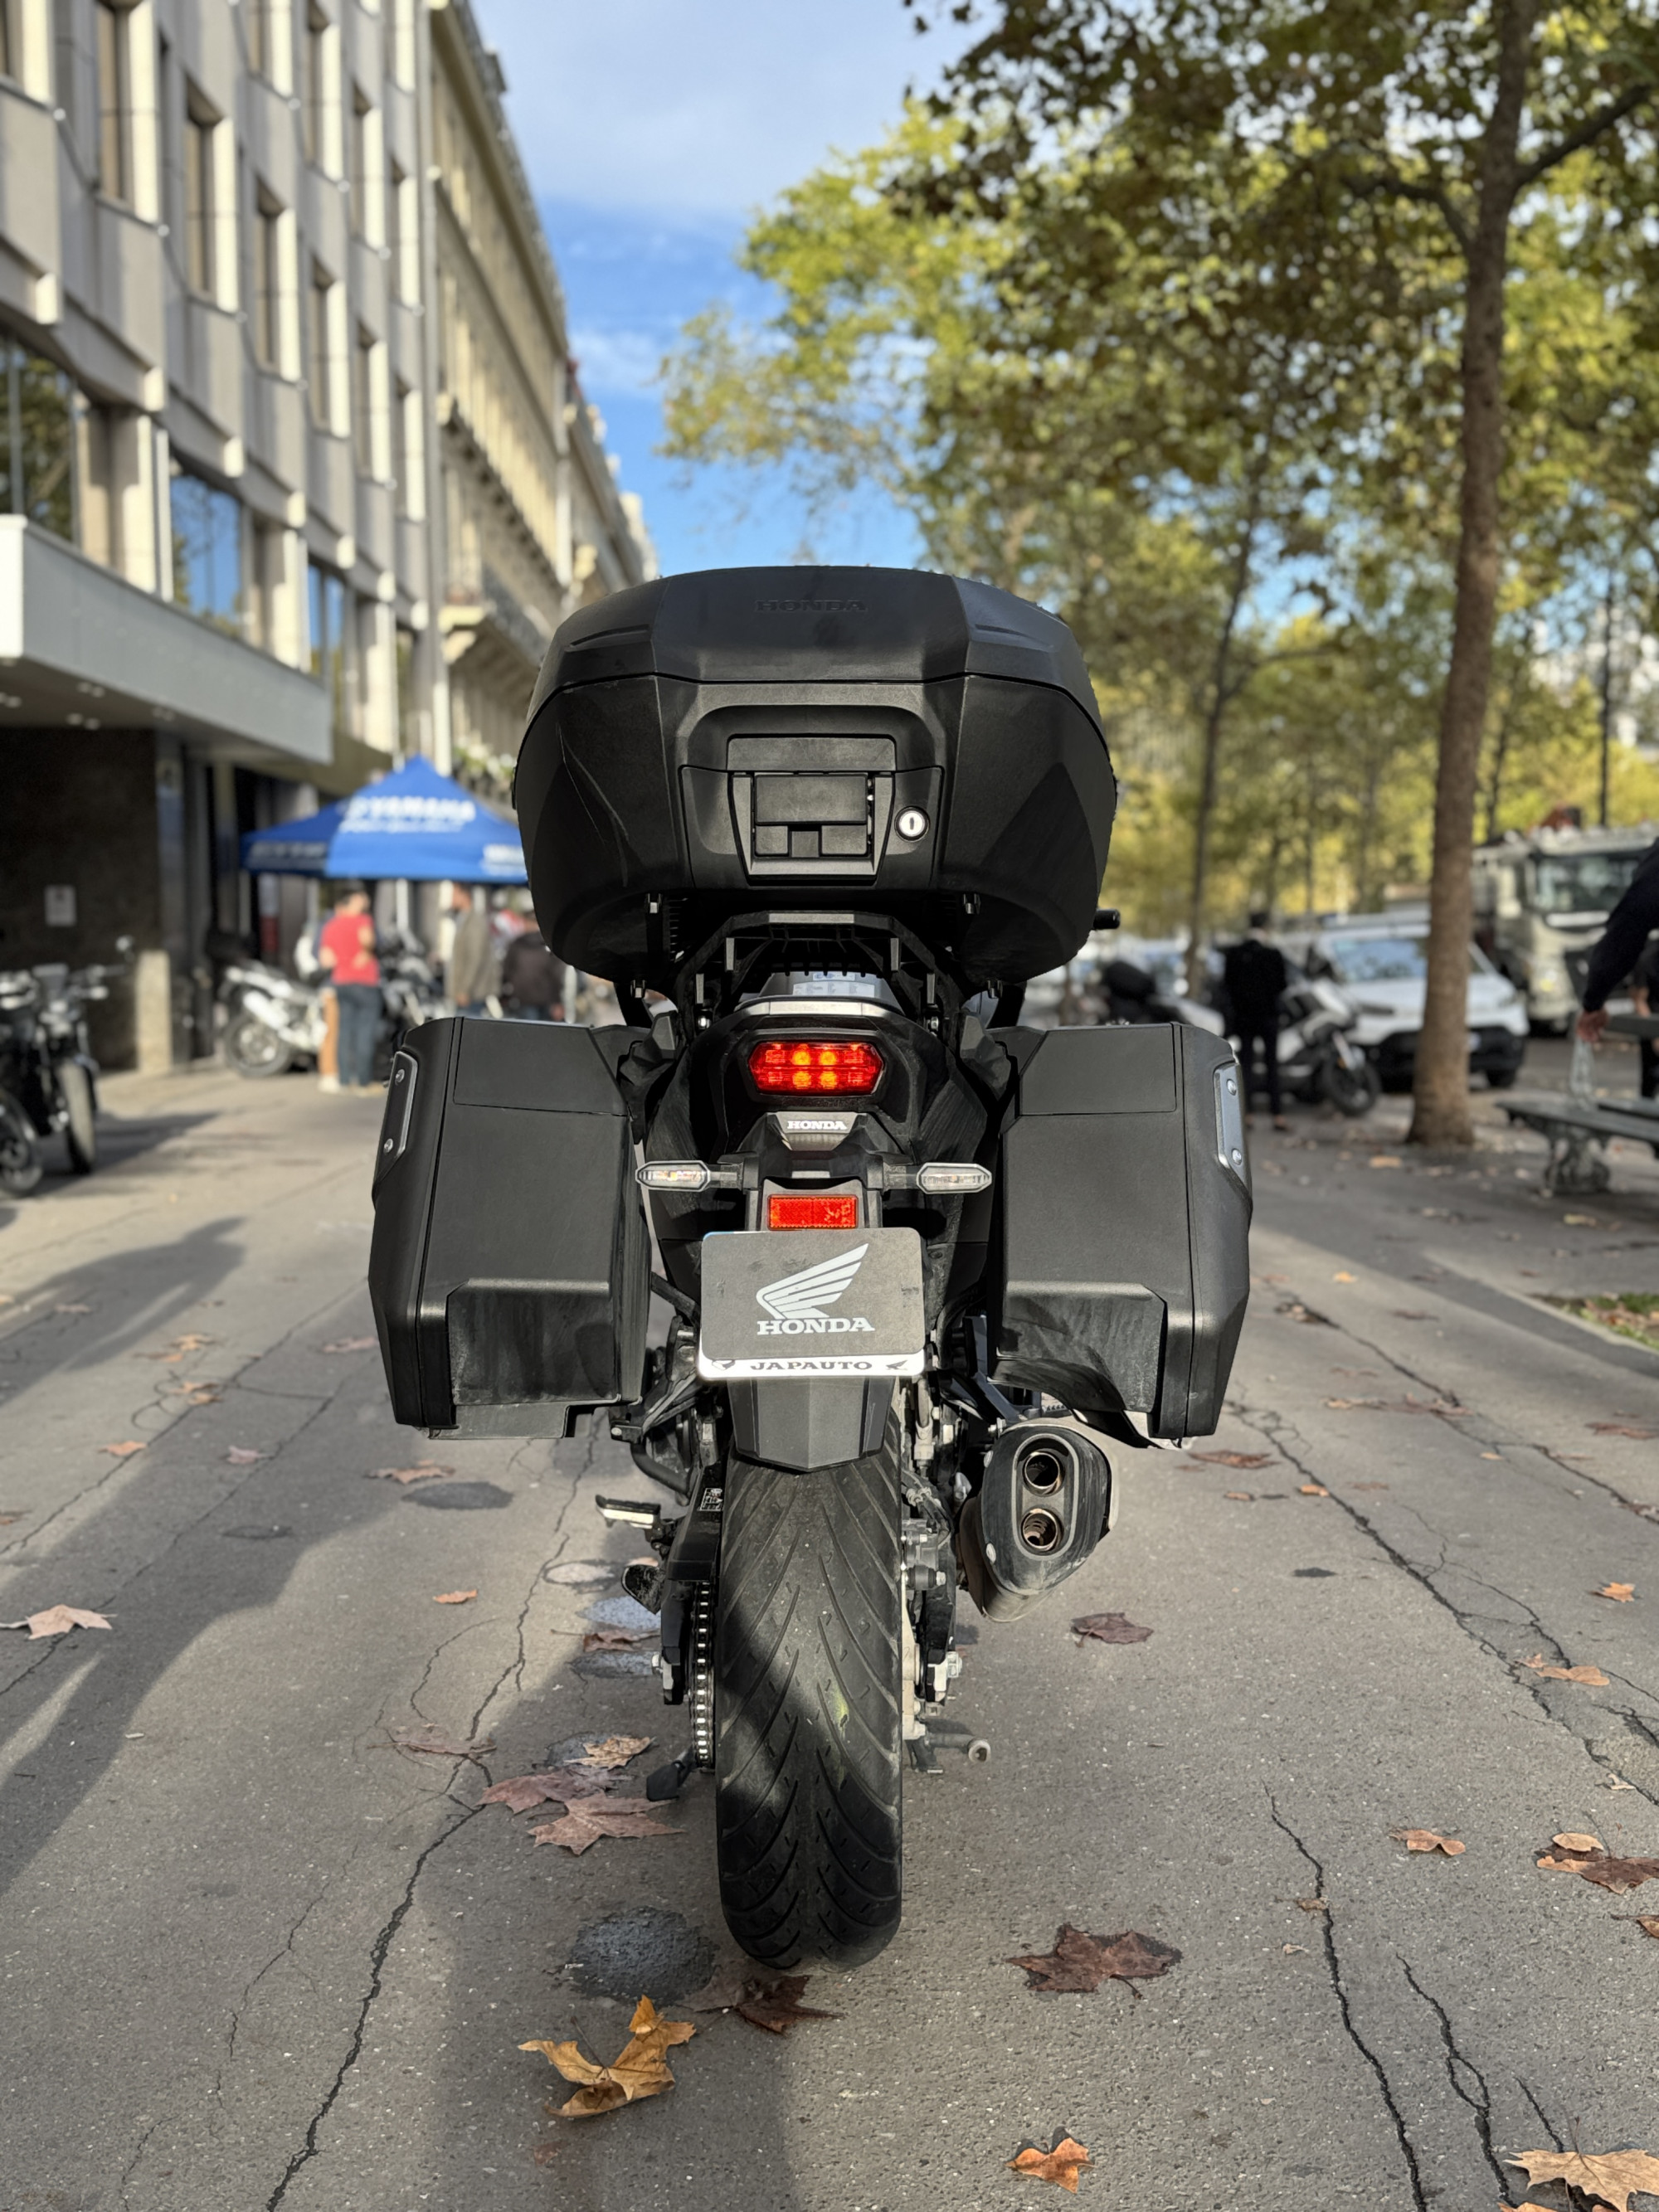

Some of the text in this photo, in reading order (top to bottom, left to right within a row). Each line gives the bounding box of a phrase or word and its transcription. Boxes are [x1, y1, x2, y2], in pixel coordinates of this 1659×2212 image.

[755, 599, 868, 612] HONDA
[787, 1121, 847, 1130] HONDA
[757, 1317, 875, 1335] HONDA
[751, 1361, 873, 1370] JAPAUTO
